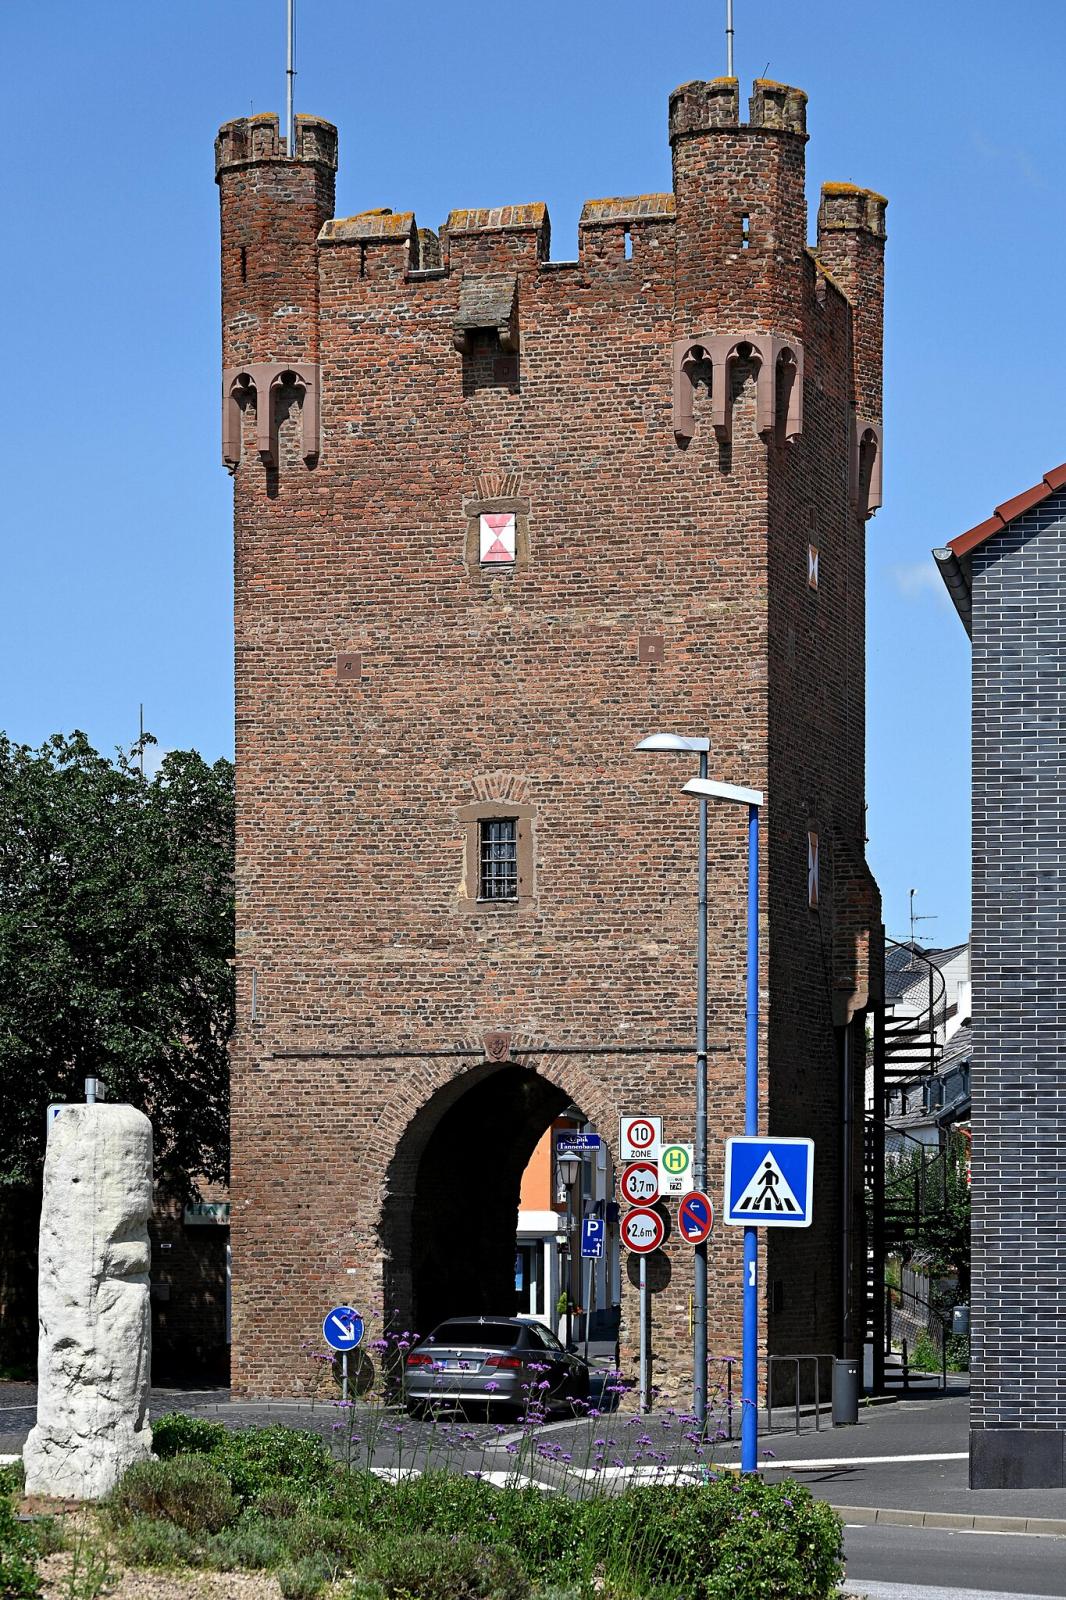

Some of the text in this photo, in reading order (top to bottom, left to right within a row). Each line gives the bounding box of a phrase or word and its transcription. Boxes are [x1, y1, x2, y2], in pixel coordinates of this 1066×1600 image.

[634, 1127, 648, 1141] 10
[630, 1150, 652, 1158] ZONE
[670, 1152, 681, 1168] H
[587, 1220, 599, 1237] P
